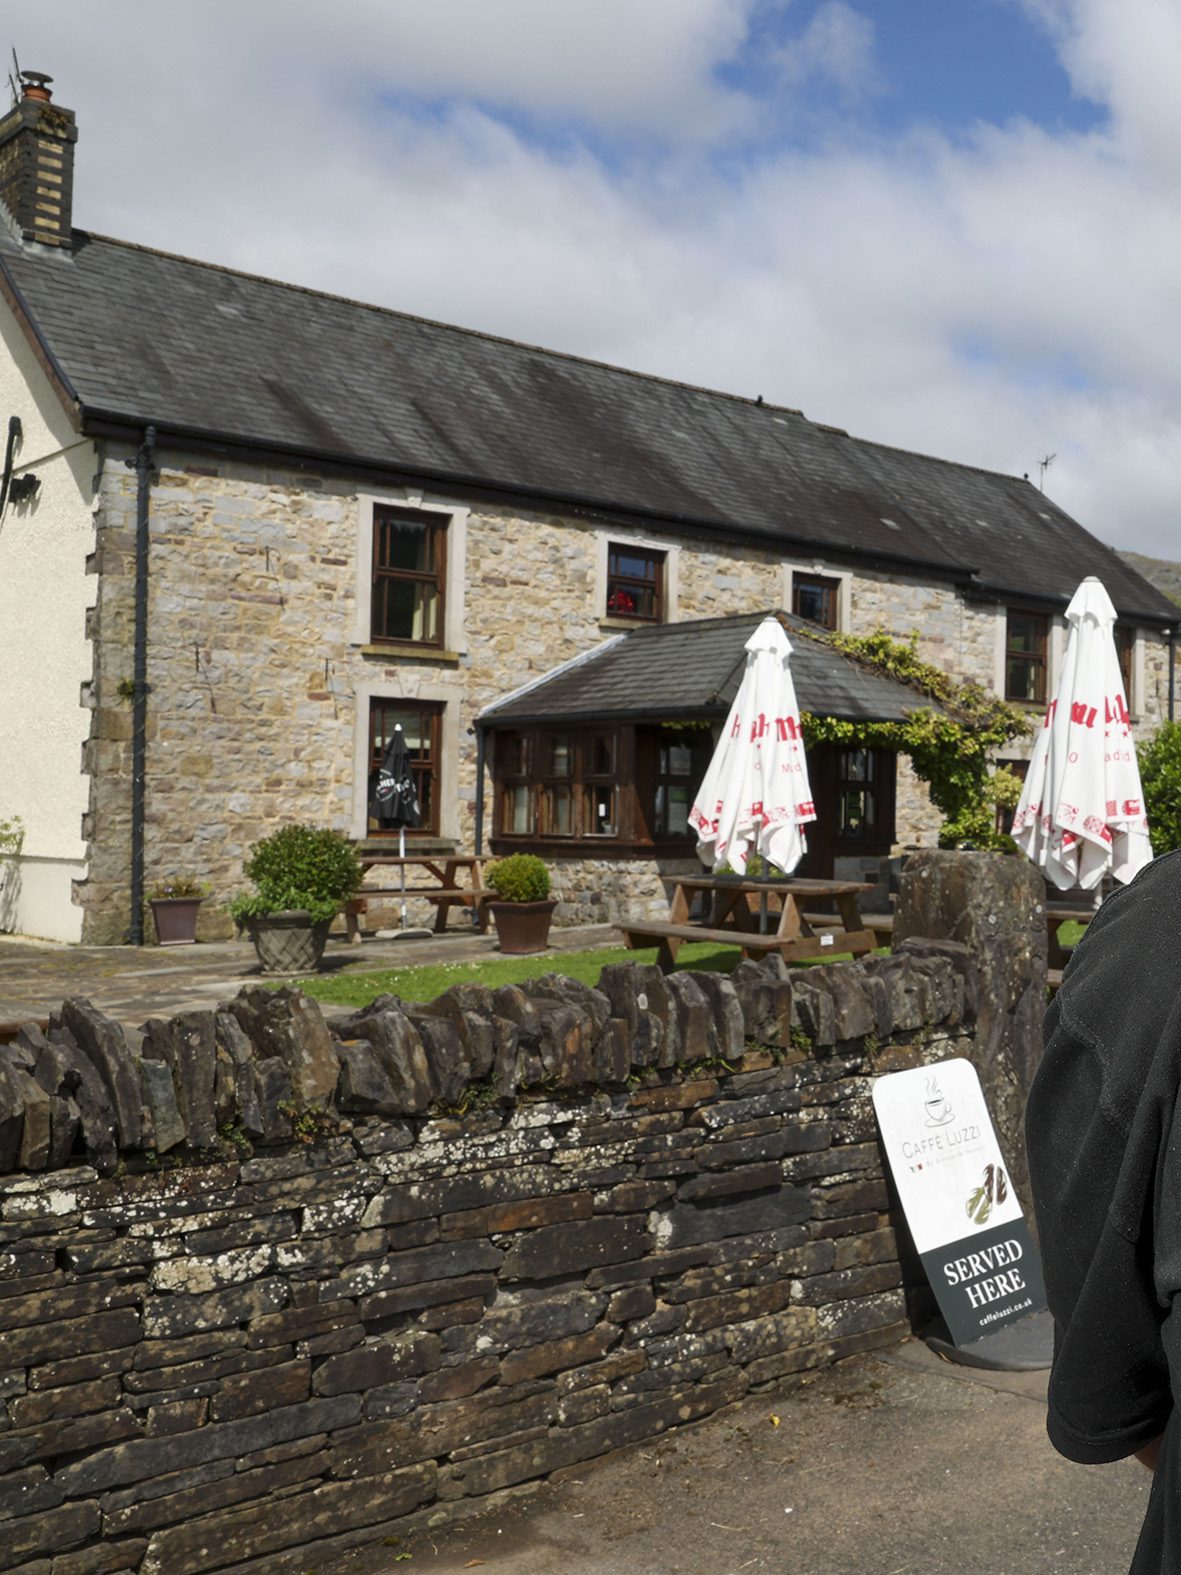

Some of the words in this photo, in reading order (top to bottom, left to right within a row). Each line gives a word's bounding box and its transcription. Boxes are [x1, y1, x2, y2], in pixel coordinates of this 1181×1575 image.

[945, 1125, 982, 1147] LUZZI
[943, 1239, 1023, 1286] SERVED
[964, 1268, 1026, 1309] HERE
